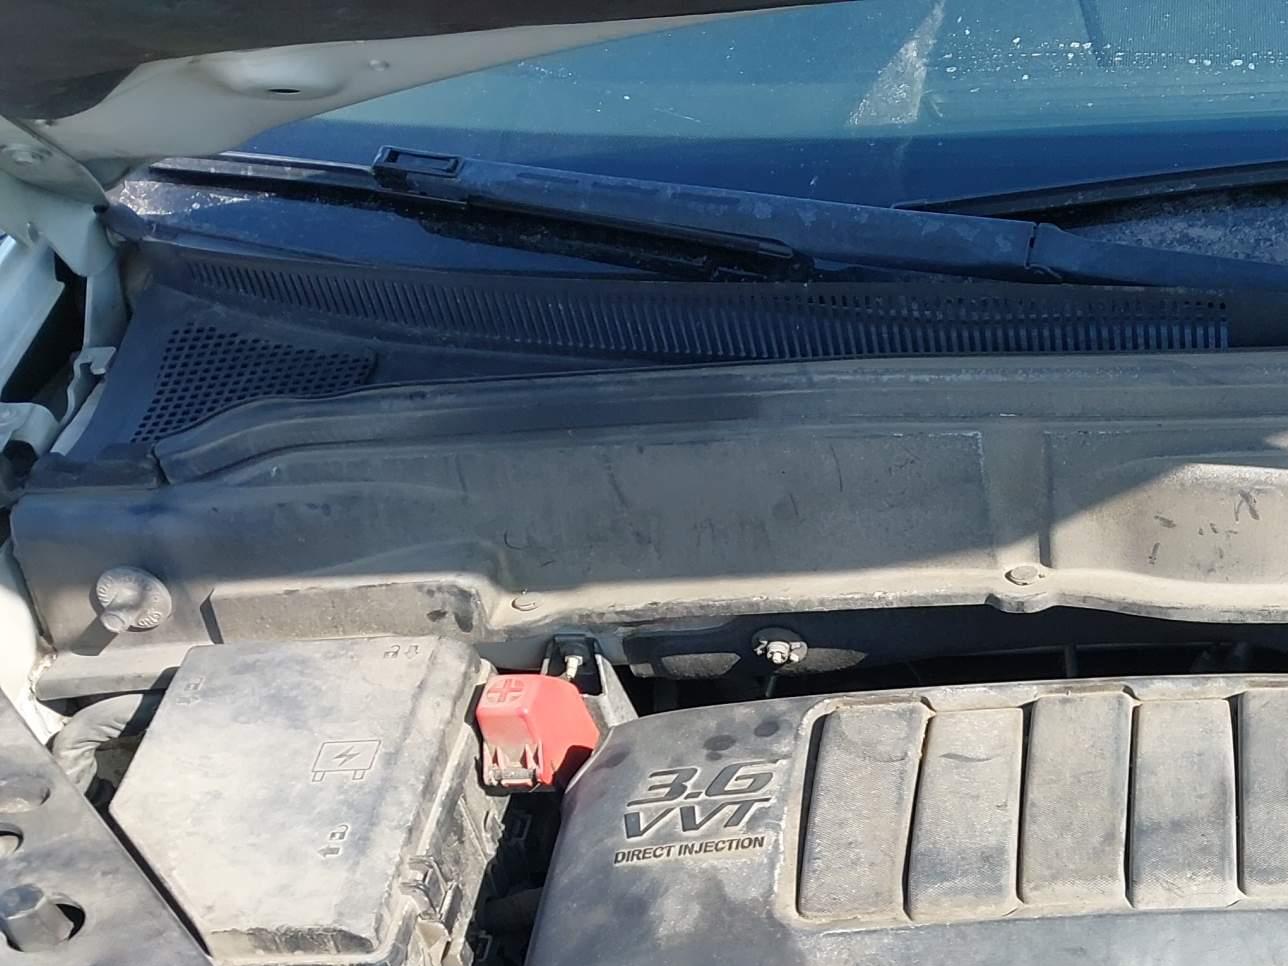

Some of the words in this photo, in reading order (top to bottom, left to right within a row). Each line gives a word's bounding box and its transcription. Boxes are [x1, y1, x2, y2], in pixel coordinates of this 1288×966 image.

[626, 759, 778, 807] 3.6
[623, 797, 773, 839] VVT
[613, 845, 674, 864] DIRECT
[678, 837, 765, 856] INJECTION
